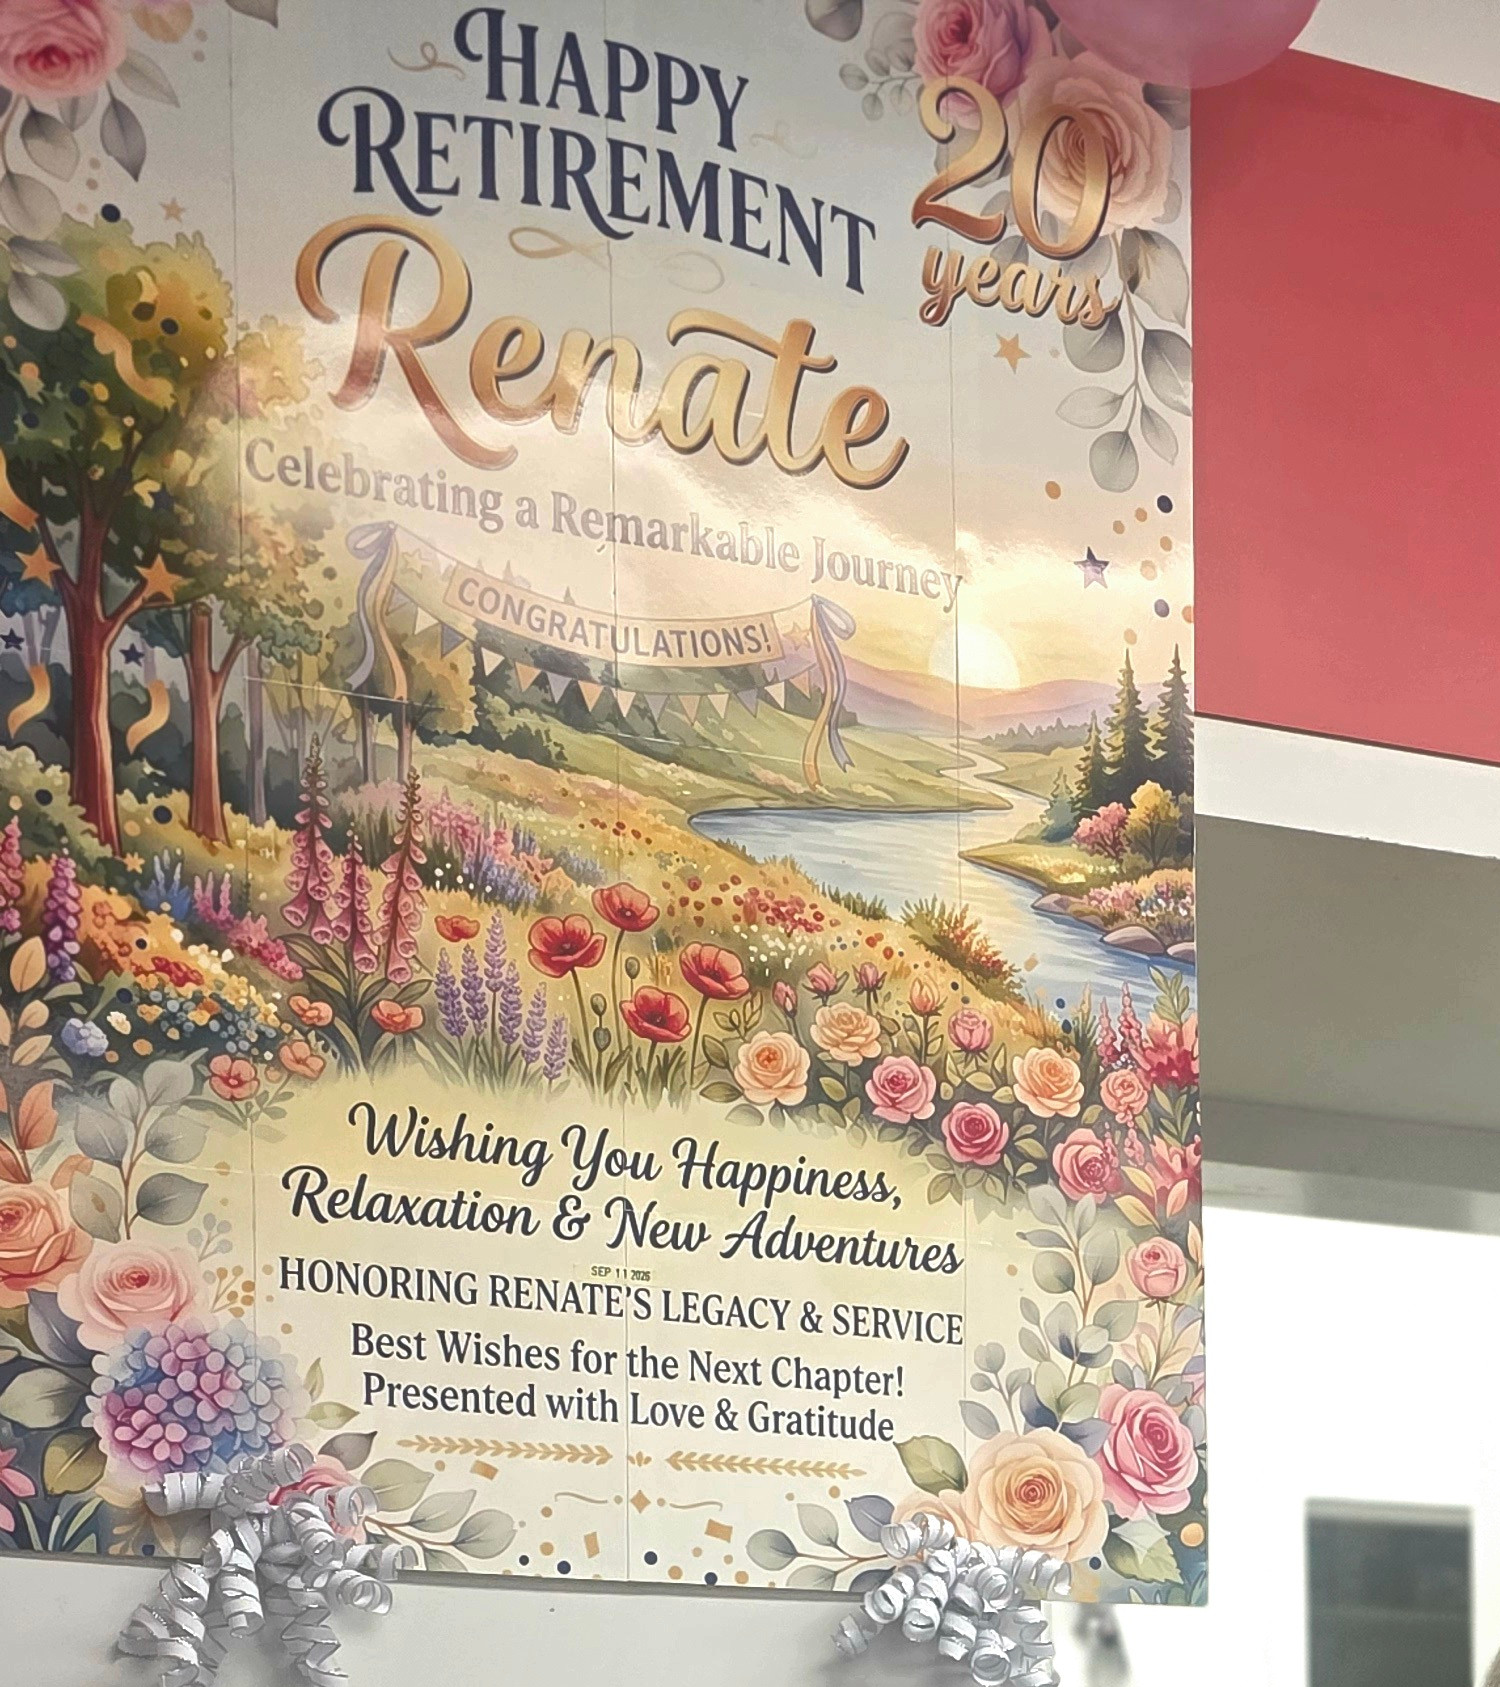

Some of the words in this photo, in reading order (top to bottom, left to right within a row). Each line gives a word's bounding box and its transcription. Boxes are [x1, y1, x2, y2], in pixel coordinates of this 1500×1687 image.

[454, 6, 749, 153] HAPPY
[317, 84, 877, 295] RETIREMENT
[911, 76, 1112, 259] 20
[916, 241, 1120, 328] years
[295, 215, 911, 491] Renate
[244, 438, 503, 531] Celebrating
[514, 497, 539, 530] a
[552, 492, 800, 575] Remarkable
[811, 538, 962, 612] Journey
[456, 577, 773, 660] CONGRATULATIONS!
[348, 1101, 554, 1188] Wishing
[561, 1124, 662, 1191] You
[672, 1136, 902, 1210] Happiness,
[281, 1164, 541, 1238] Relaxation
[552, 1194, 590, 1241] &
[604, 1199, 711, 1252] New
[720, 1209, 964, 1274] Adventures
[591, 1266, 611, 1277] SEP
[616, 1268, 627, 1279] 11
[279, 1256, 478, 1306] HONORING
[489, 1274, 651, 1321] RENATE'S
[662, 1290, 791, 1331] LEGACY
[800, 1302, 824, 1335] &
[832, 1305, 964, 1345] SERVICE
[351, 1322, 426, 1361] Best
[436, 1329, 561, 1374] Wishes
[570, 1339, 618, 1379] for
[626, 1345, 679, 1381] the
[689, 1350, 762, 1388] Next
[771, 1355, 905, 1399] Chapter!
[362, 1372, 536, 1418] Presented
[546, 1386, 619, 1422] with
[629, 1391, 705, 1431] Love
[714, 1400, 739, 1430] &
[748, 1401, 895, 1442] Gratitude
